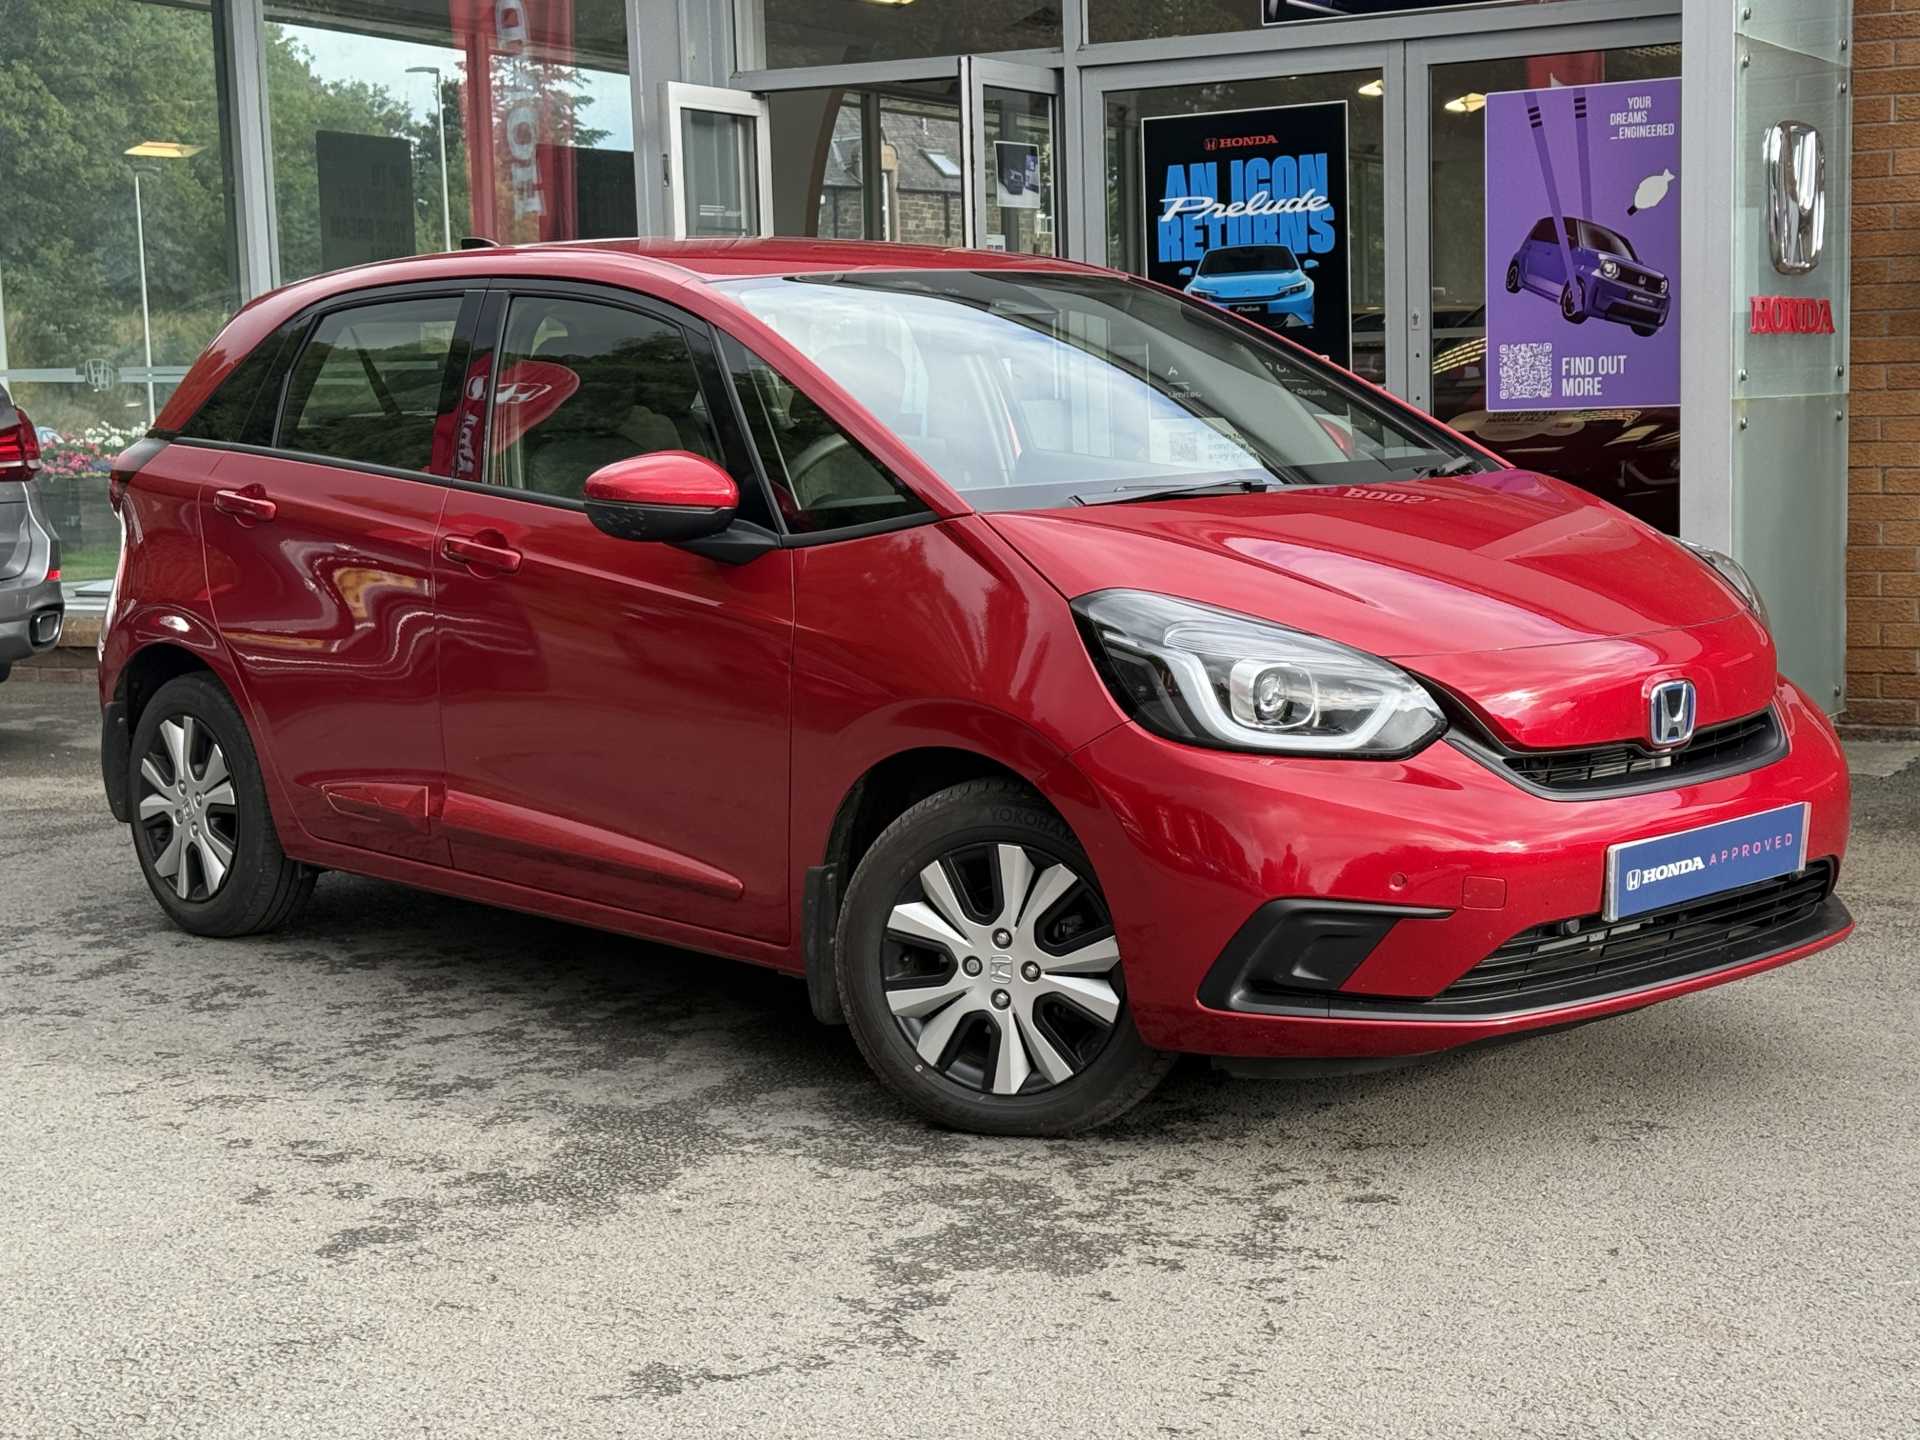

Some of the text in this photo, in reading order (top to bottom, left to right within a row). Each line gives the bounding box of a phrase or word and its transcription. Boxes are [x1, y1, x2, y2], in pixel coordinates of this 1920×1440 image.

[1627, 96, 1652, 109] YOUR
[1610, 110, 1648, 126] DREAMS
[1218, 134, 1279, 148] HONDA
[1163, 152, 1329, 213] AN ICON
[1160, 188, 1332, 222] Prelude
[1157, 206, 1336, 263] RETURNS
[1750, 295, 1836, 335] HONDA
[1562, 355, 1628, 376] FIND OUT
[1562, 377, 1603, 397] MORE
[1642, 832, 1793, 884] HONDA APPROVED
